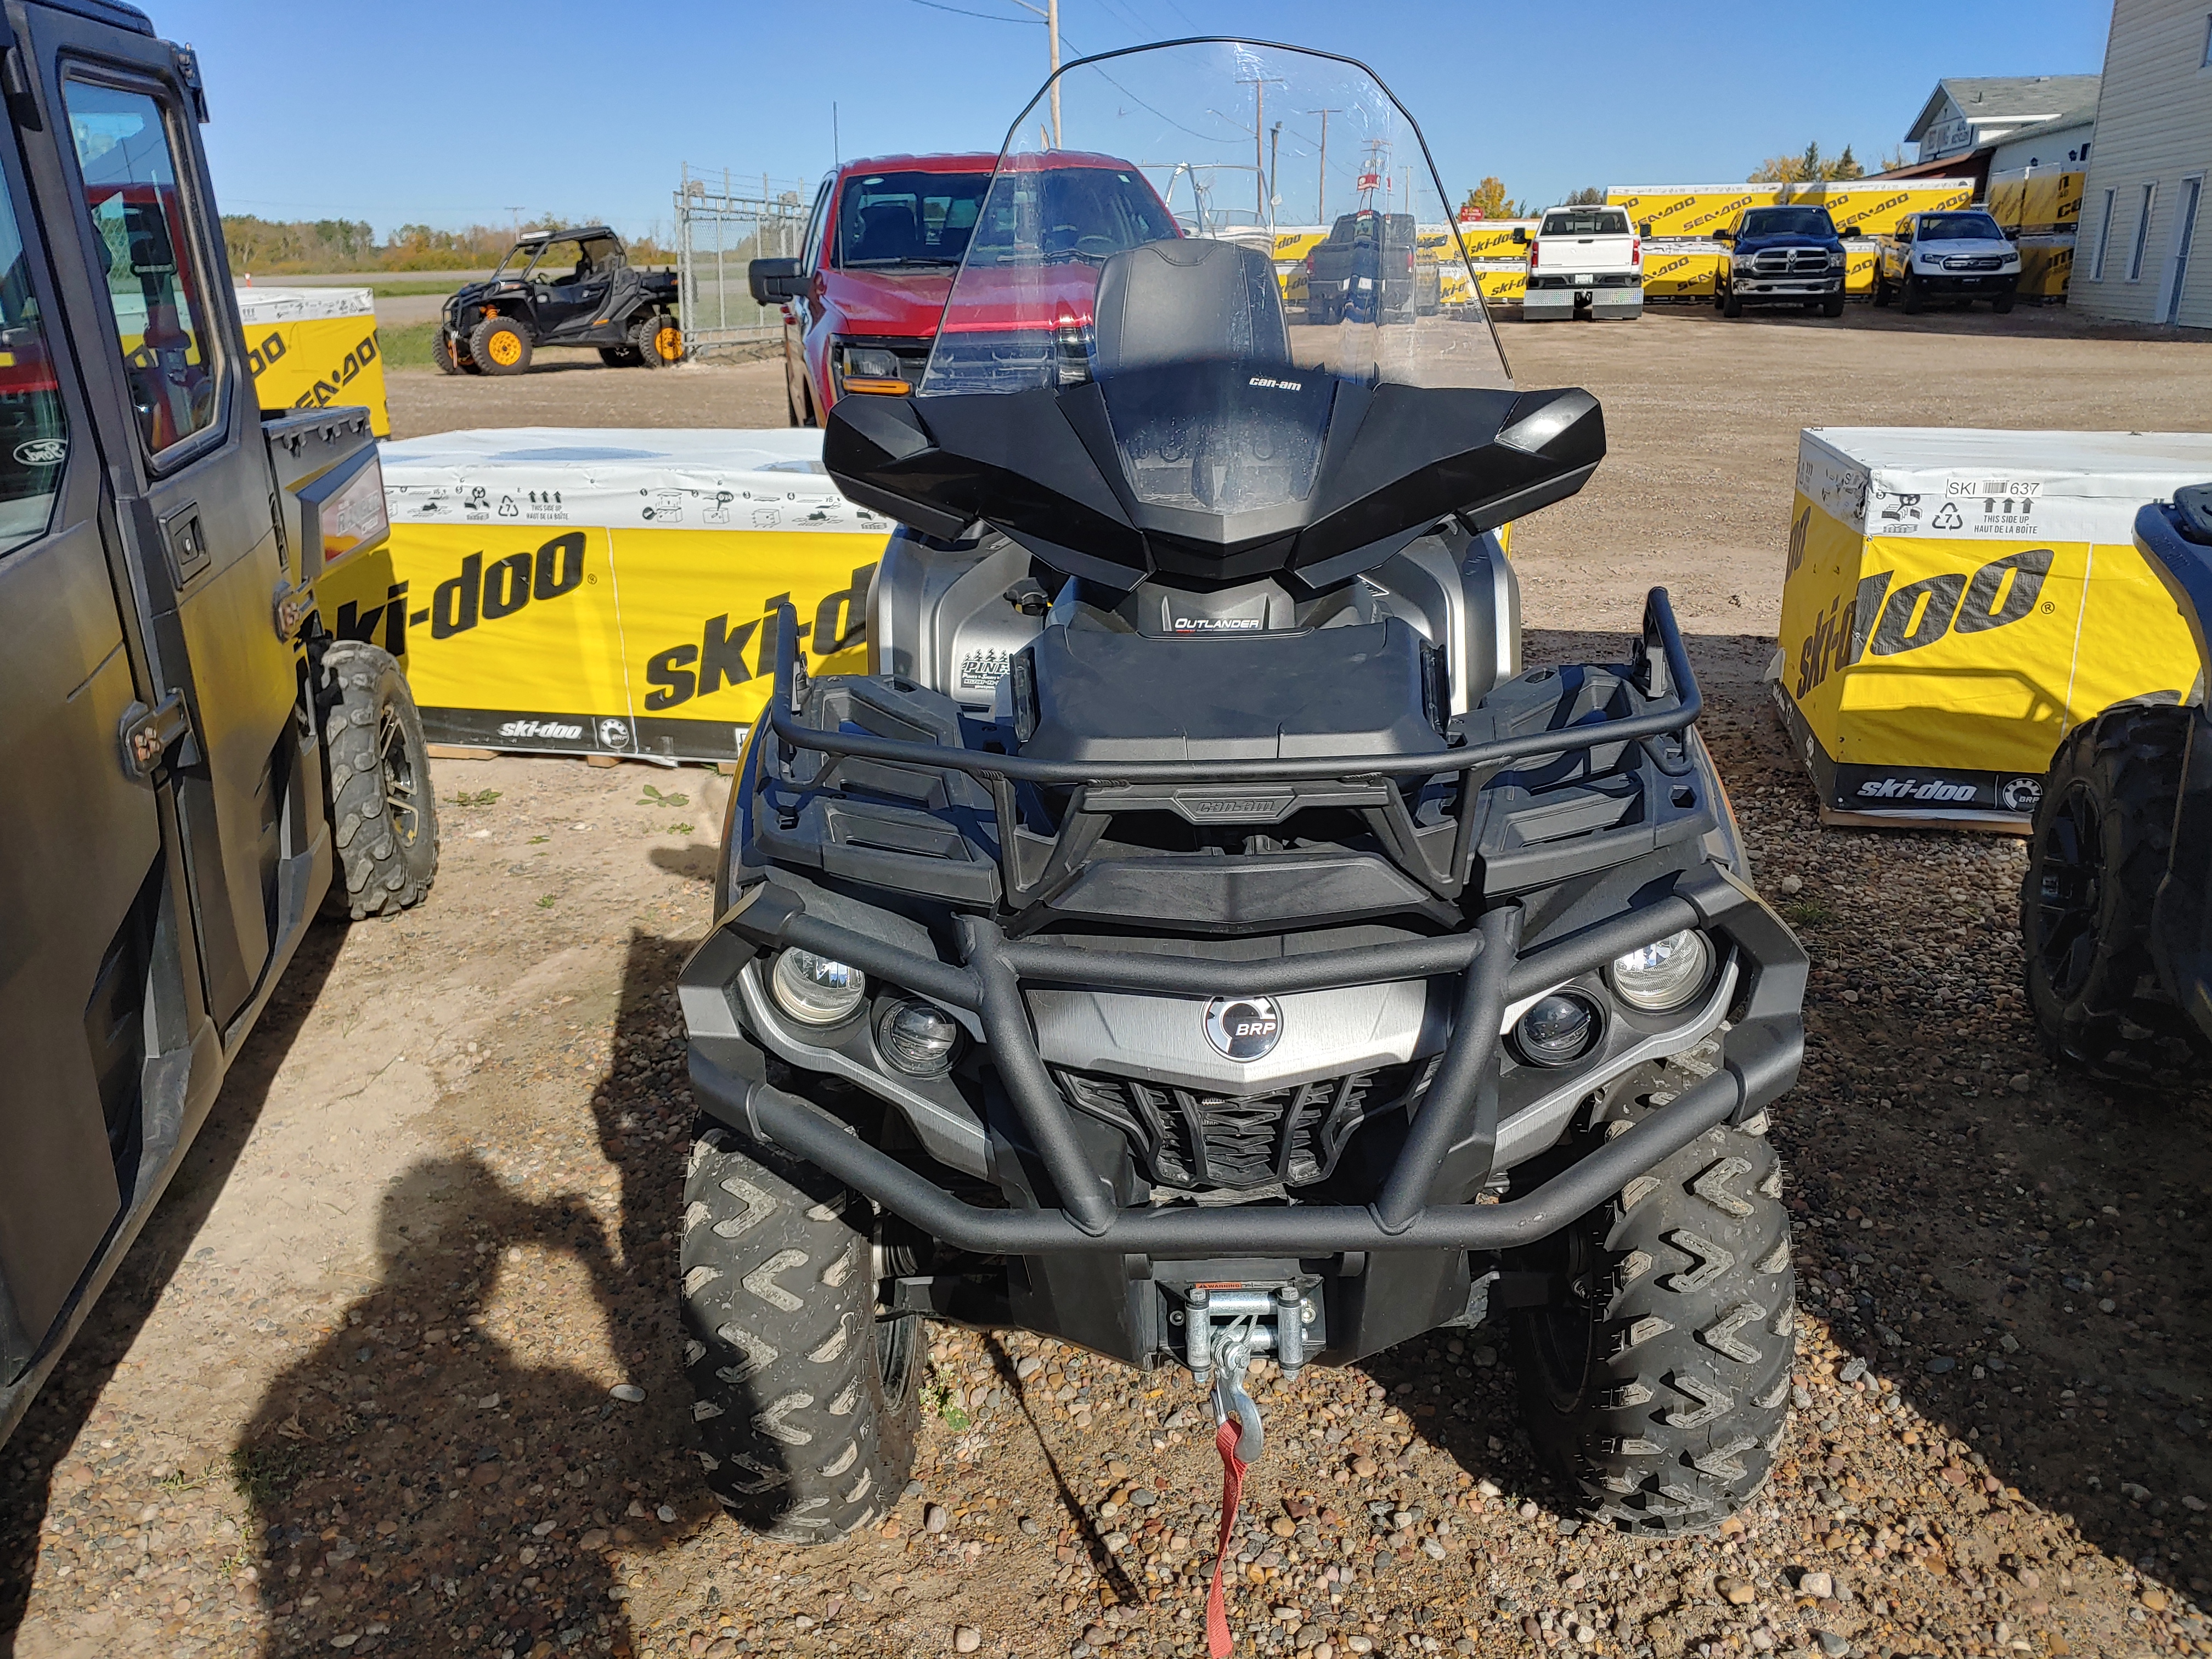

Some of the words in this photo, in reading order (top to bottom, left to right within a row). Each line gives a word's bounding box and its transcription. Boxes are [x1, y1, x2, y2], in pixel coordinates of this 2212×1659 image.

[1491, 276, 1527, 295] ski-d
[1249, 377, 1301, 391] can-am
[1949, 482, 1976, 495] SKI
[2010, 482, 2040, 495] 637
[1945, 514, 1952, 523] 7
[2019, 516, 2029, 524] UP
[2005, 526, 2013, 534] LA
[2016, 523, 2038, 534] BOÎTE
[336, 532, 586, 657] ki-doo
[1175, 618, 1259, 628] OUTLANDER
[644, 561, 878, 711] ski-d
[498, 720, 583, 739] ski-doo
[1857, 779, 1977, 801] ski-doo
[1197, 801, 1274, 812] can-am
[1235, 1022, 1276, 1036] BRP
